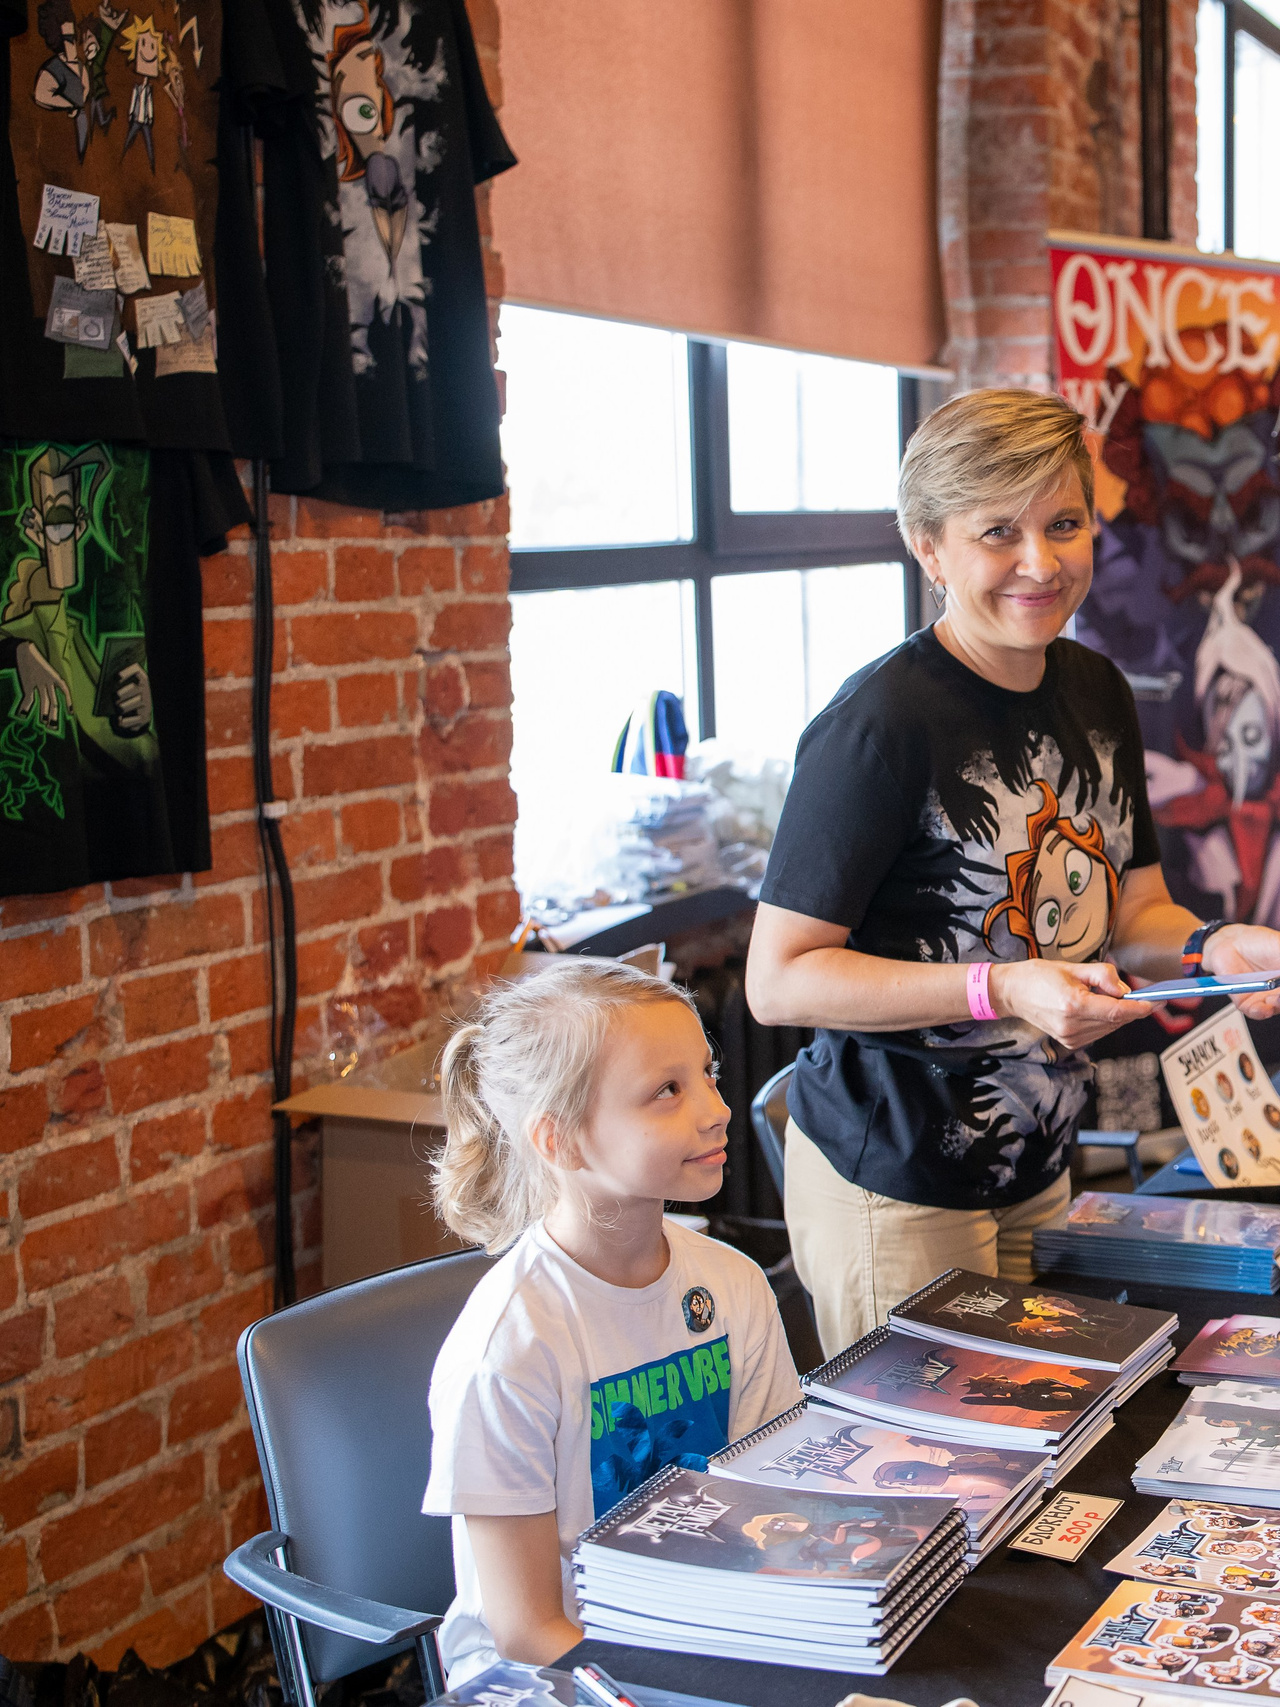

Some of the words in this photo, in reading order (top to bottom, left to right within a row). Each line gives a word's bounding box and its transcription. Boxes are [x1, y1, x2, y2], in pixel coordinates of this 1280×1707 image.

[1056, 254, 1279, 374] ONCE
[591, 1362, 684, 1441] SMMER
[679, 1340, 731, 1402] VBE
[771, 1438, 829, 1479] METAL
[804, 1436, 861, 1478] FAMILY
[635, 1500, 693, 1539] METAL
[668, 1494, 728, 1537] FAMILY
[1020, 1496, 1082, 1546] БЛОКНОТ
[1057, 1520, 1093, 1544] 300
